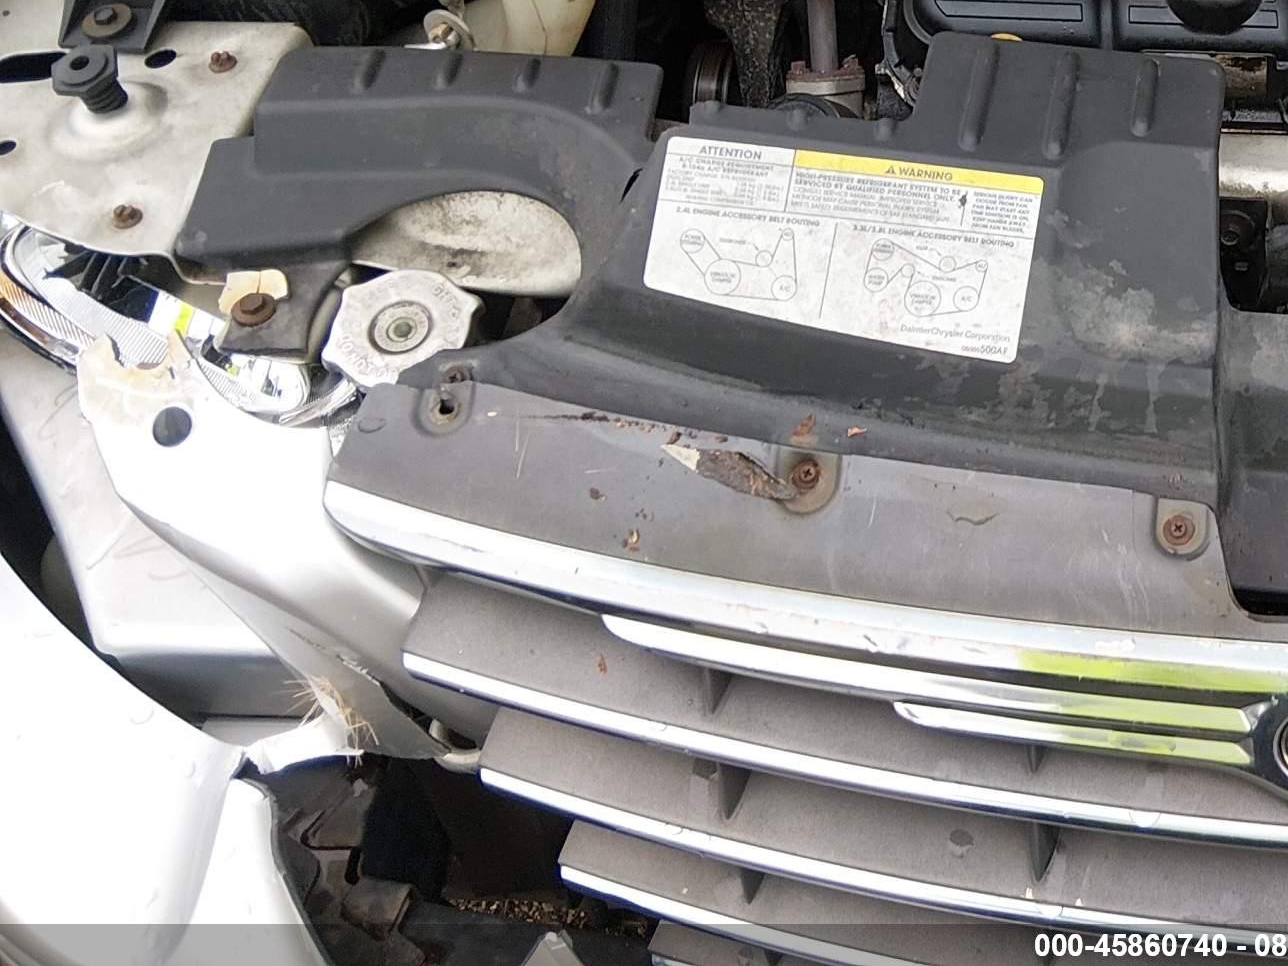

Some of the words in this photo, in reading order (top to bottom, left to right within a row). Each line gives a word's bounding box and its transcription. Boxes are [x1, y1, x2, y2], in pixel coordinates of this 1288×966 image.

[700, 145, 762, 160] ATTENTION
[899, 165, 953, 182] WARNING
[900, 323, 964, 338] DaimlerChrysler
[964, 330, 1011, 343] Corporation
